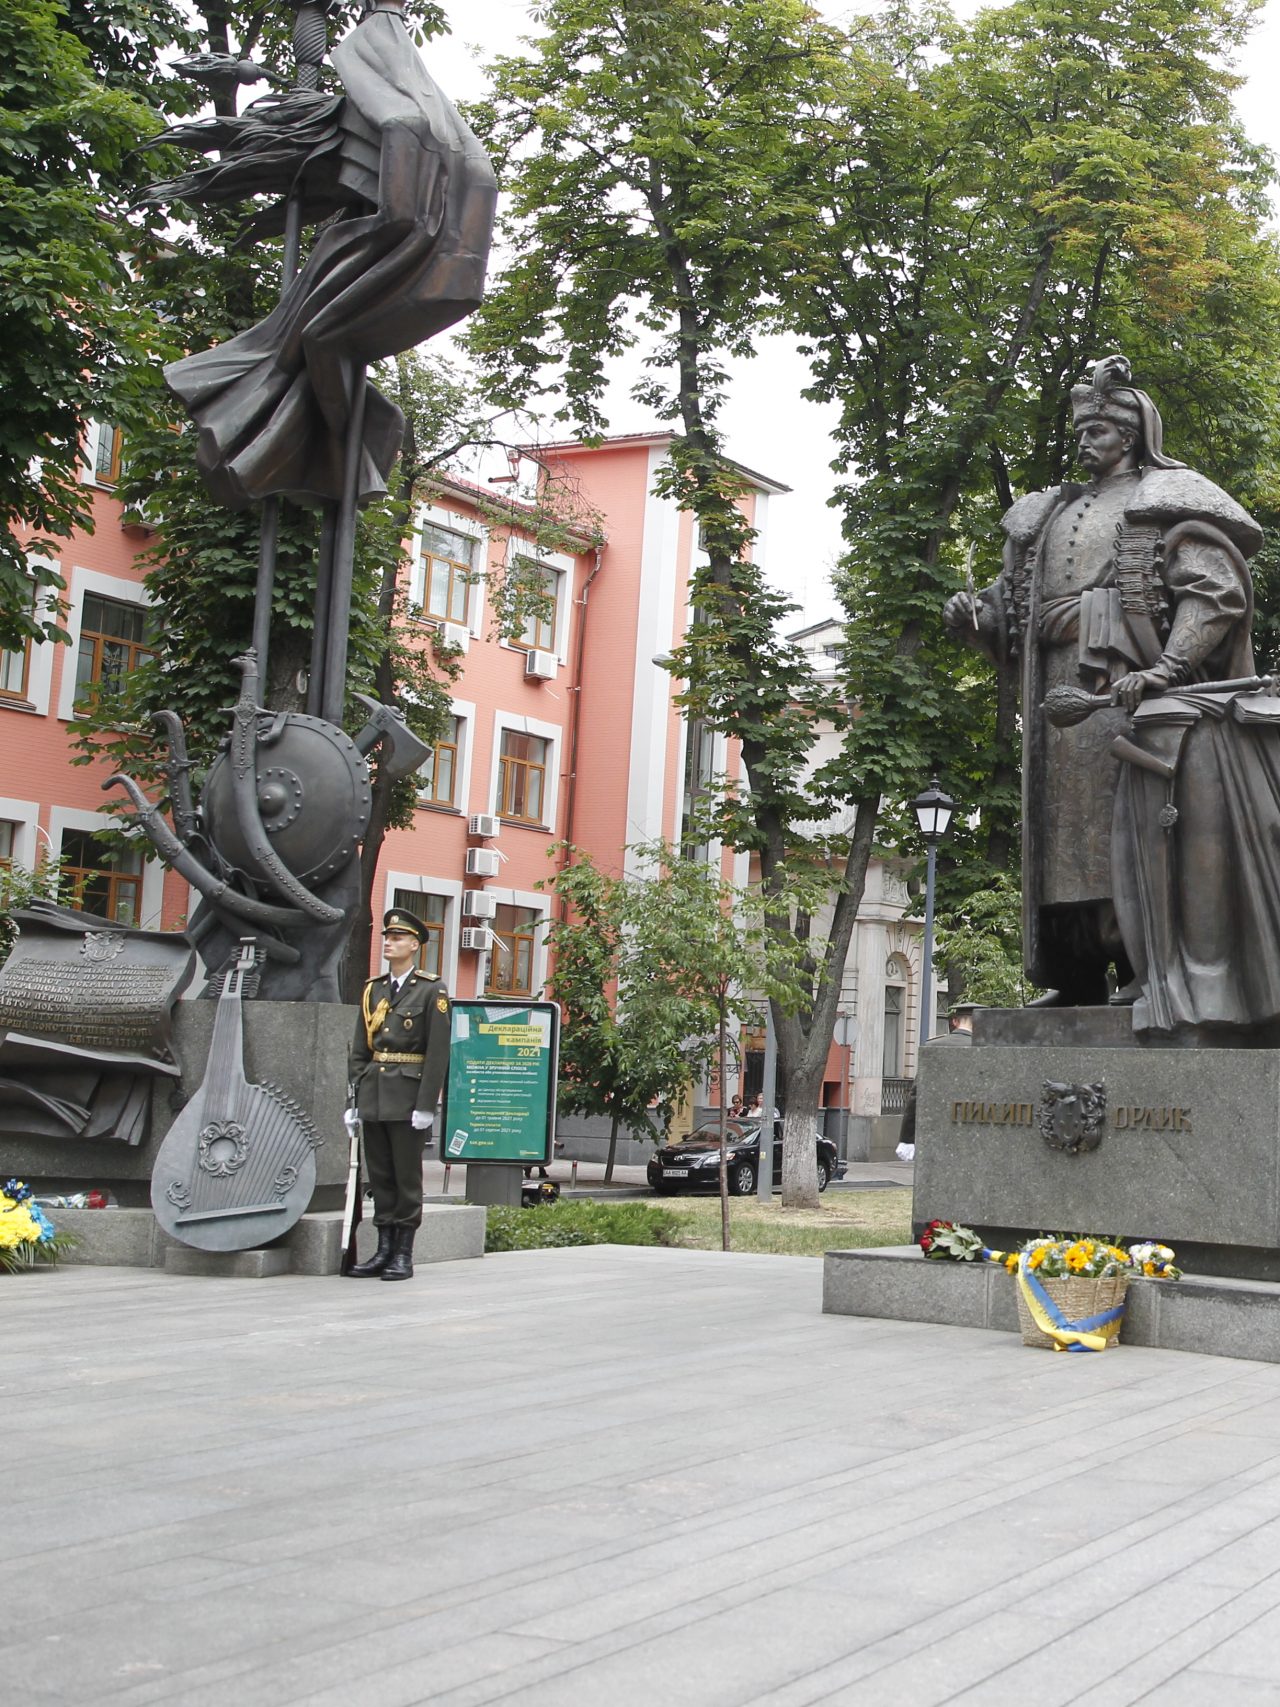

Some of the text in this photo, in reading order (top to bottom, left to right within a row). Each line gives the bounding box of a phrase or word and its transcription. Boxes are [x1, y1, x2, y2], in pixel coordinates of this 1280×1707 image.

[0, 1017, 29, 1030] ЕРША
[488, 1024, 542, 1033] Деклараційна
[517, 1048, 541, 1057] 2021
[951, 1101, 1193, 1132] ПИЛИП ОРЛИК
